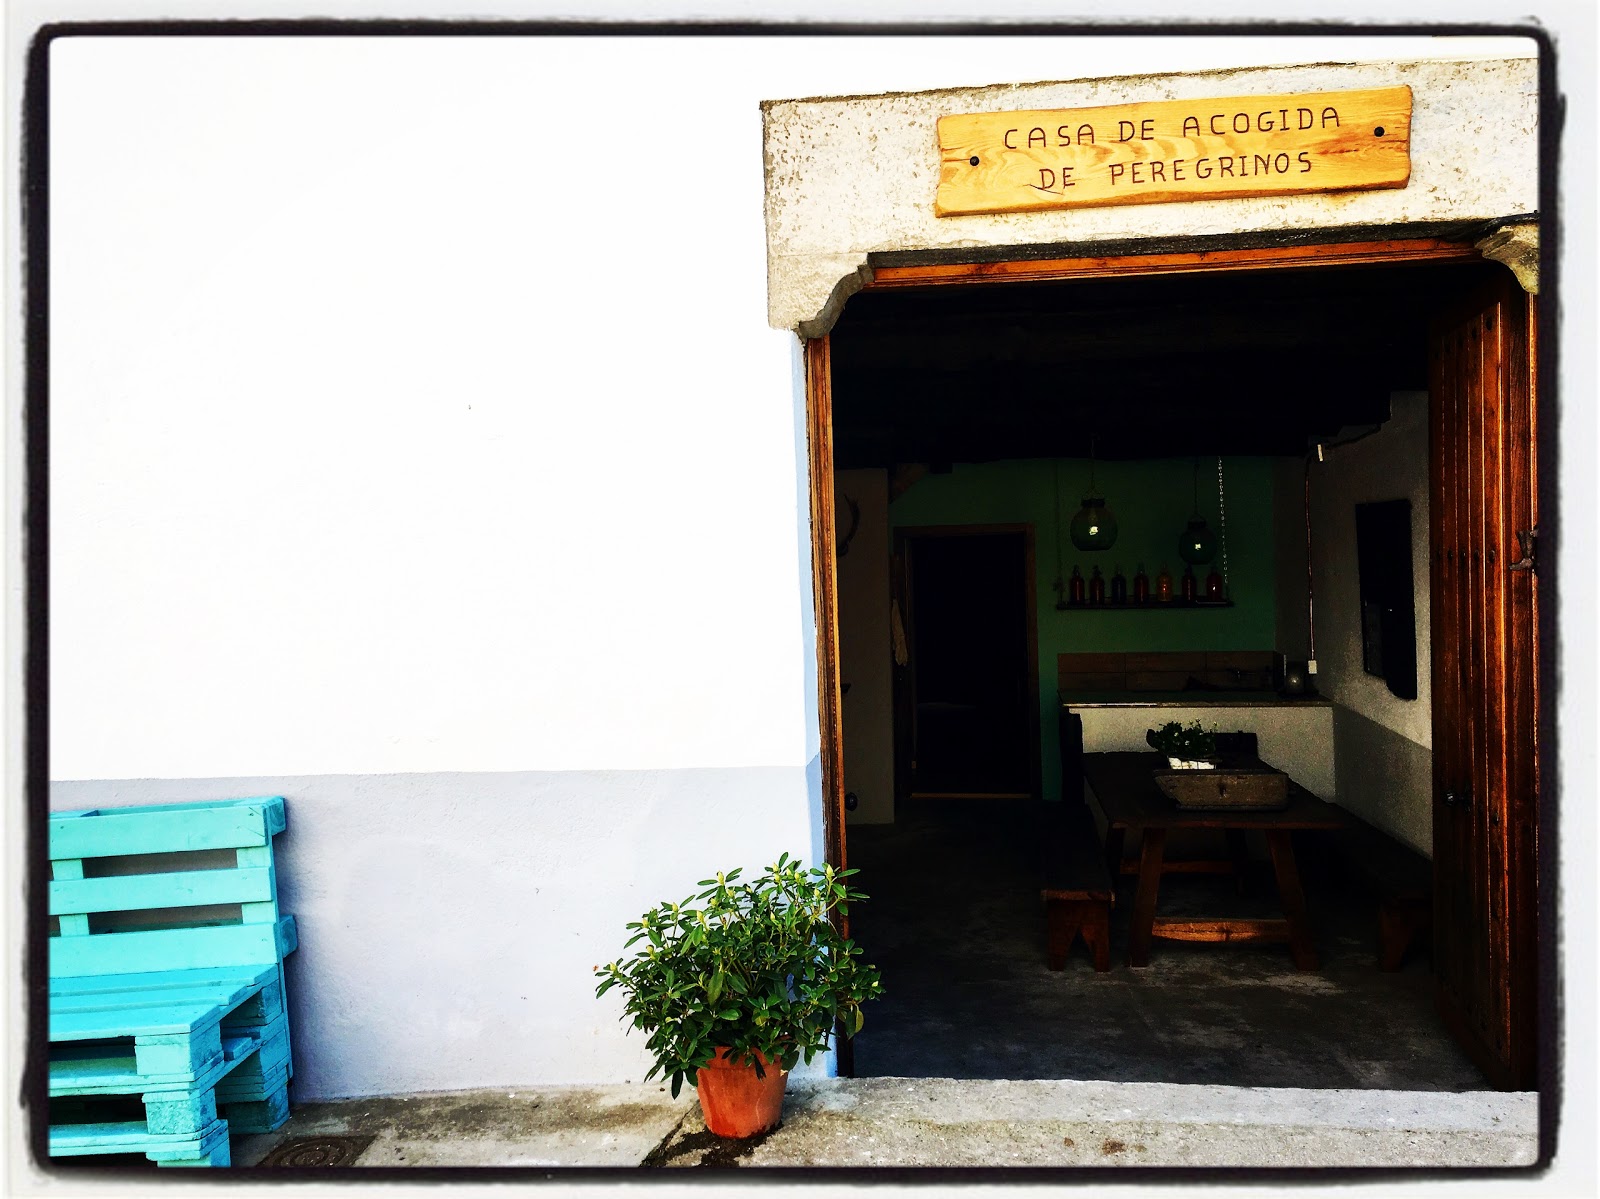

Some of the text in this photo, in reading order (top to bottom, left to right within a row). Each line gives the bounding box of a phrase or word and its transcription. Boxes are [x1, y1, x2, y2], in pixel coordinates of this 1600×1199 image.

[1004, 106, 1341, 149] CASA DE ACOGIDA
[1040, 151, 1313, 190] DE PEREGRINOS
